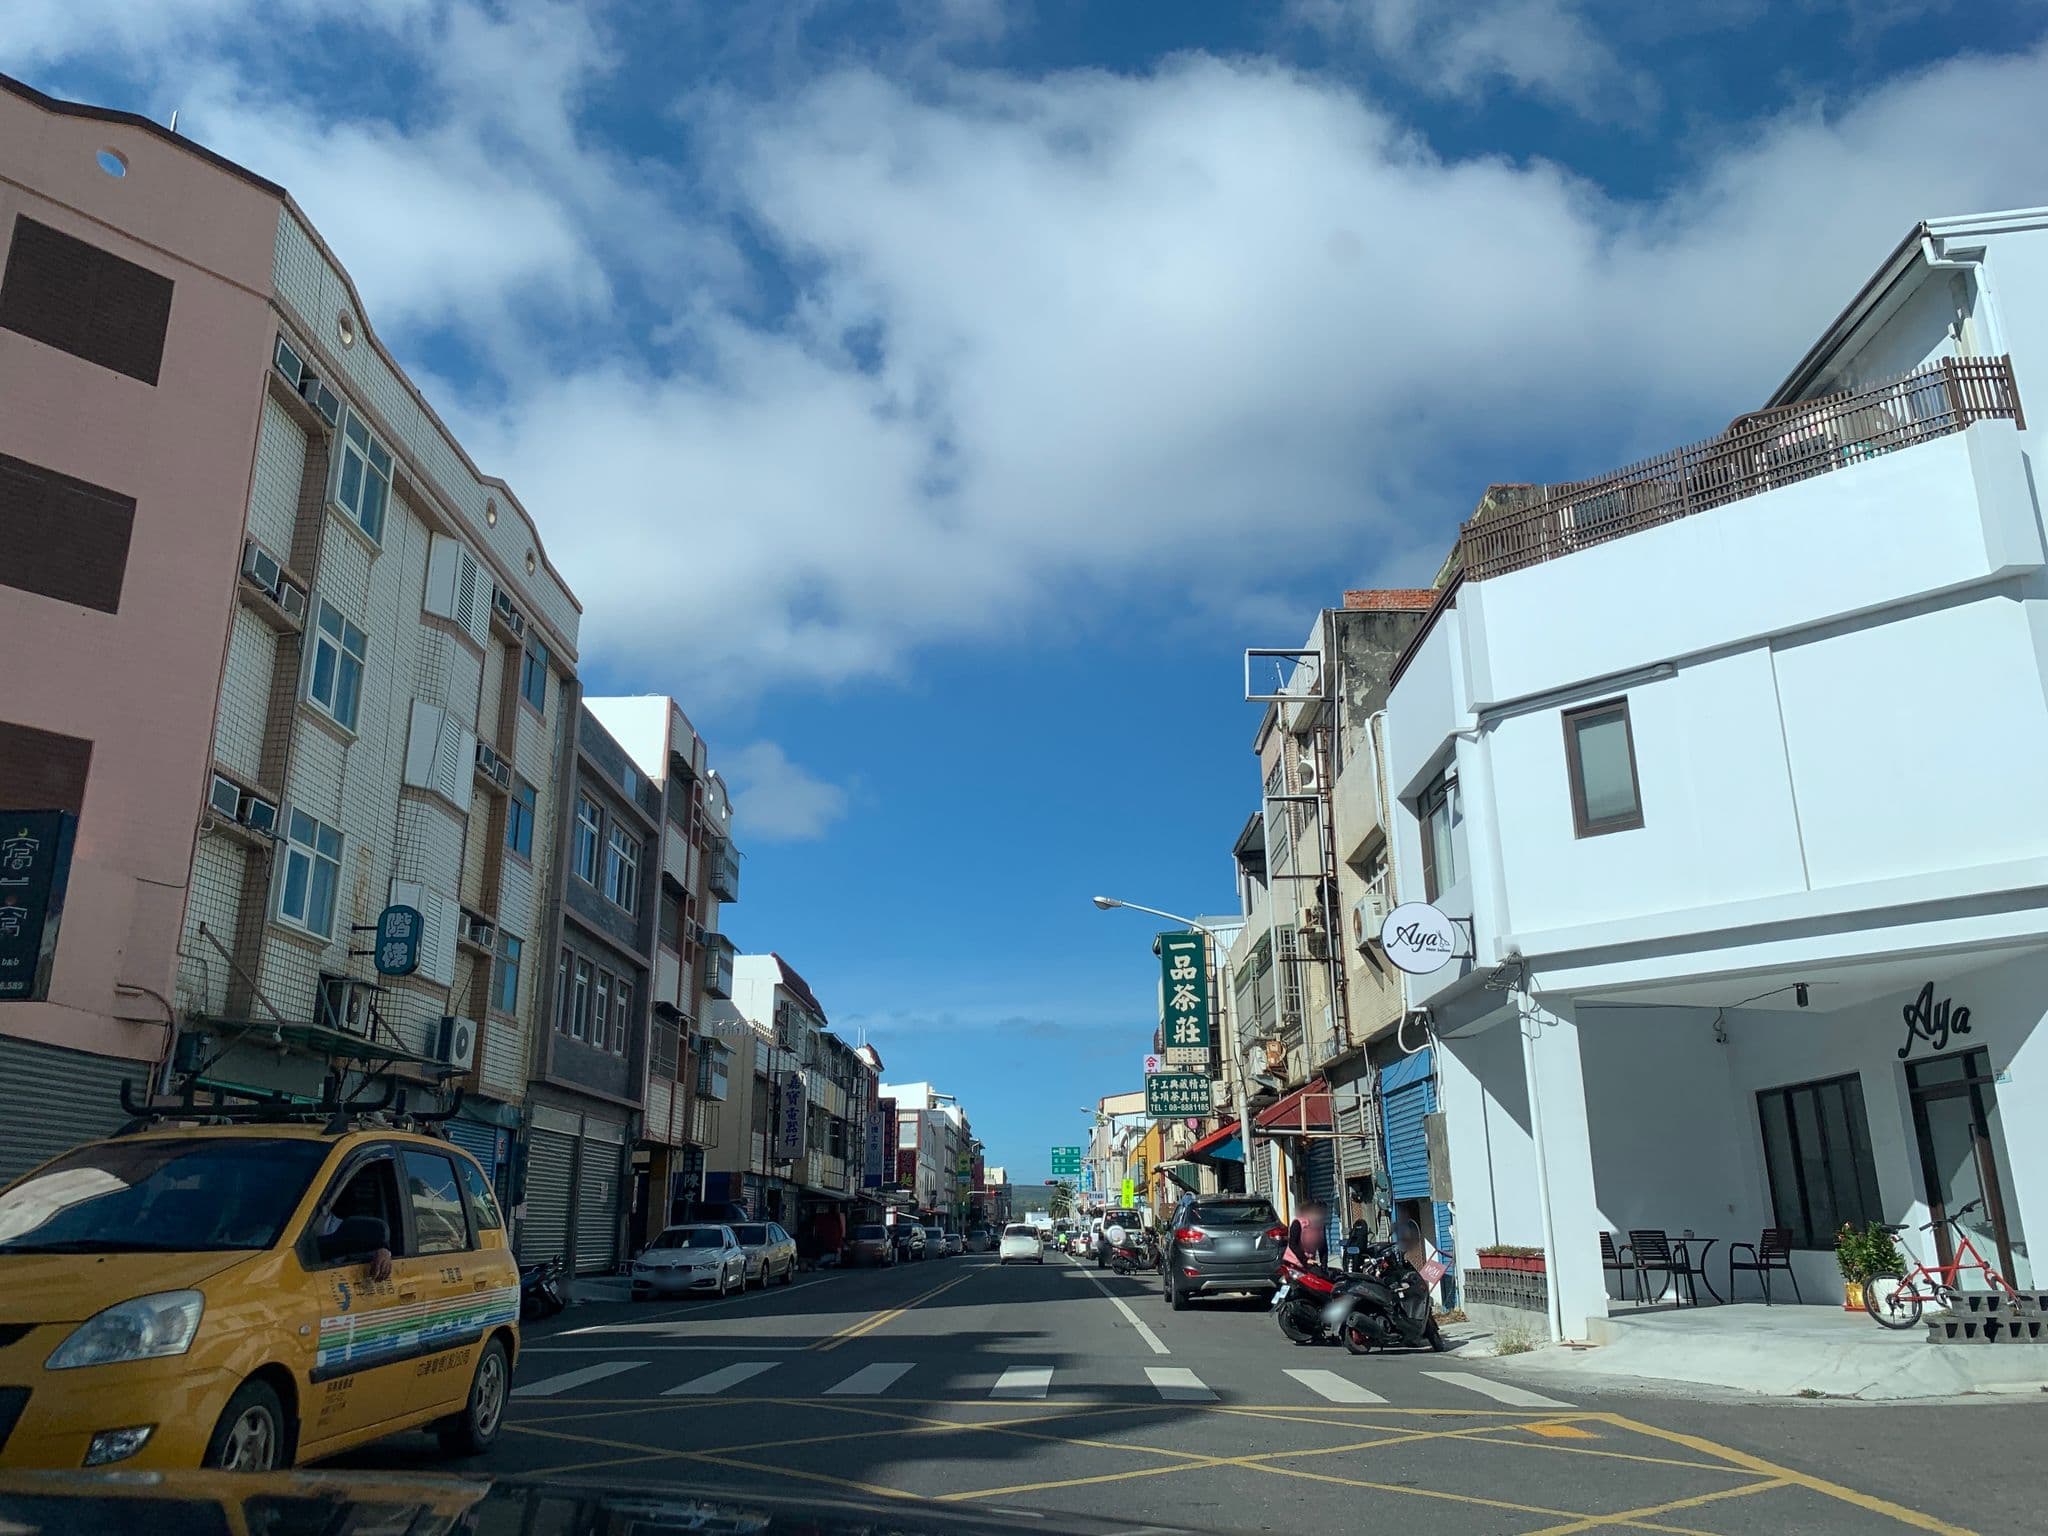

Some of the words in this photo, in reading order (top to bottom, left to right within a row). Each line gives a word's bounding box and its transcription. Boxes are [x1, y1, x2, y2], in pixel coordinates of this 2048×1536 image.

[382, 913, 413, 968] 階梯
[1386, 923, 1438, 953] Aya
[1169, 942, 1201, 1044] 一品茶莊
[1898, 981, 1971, 1058] Aya
